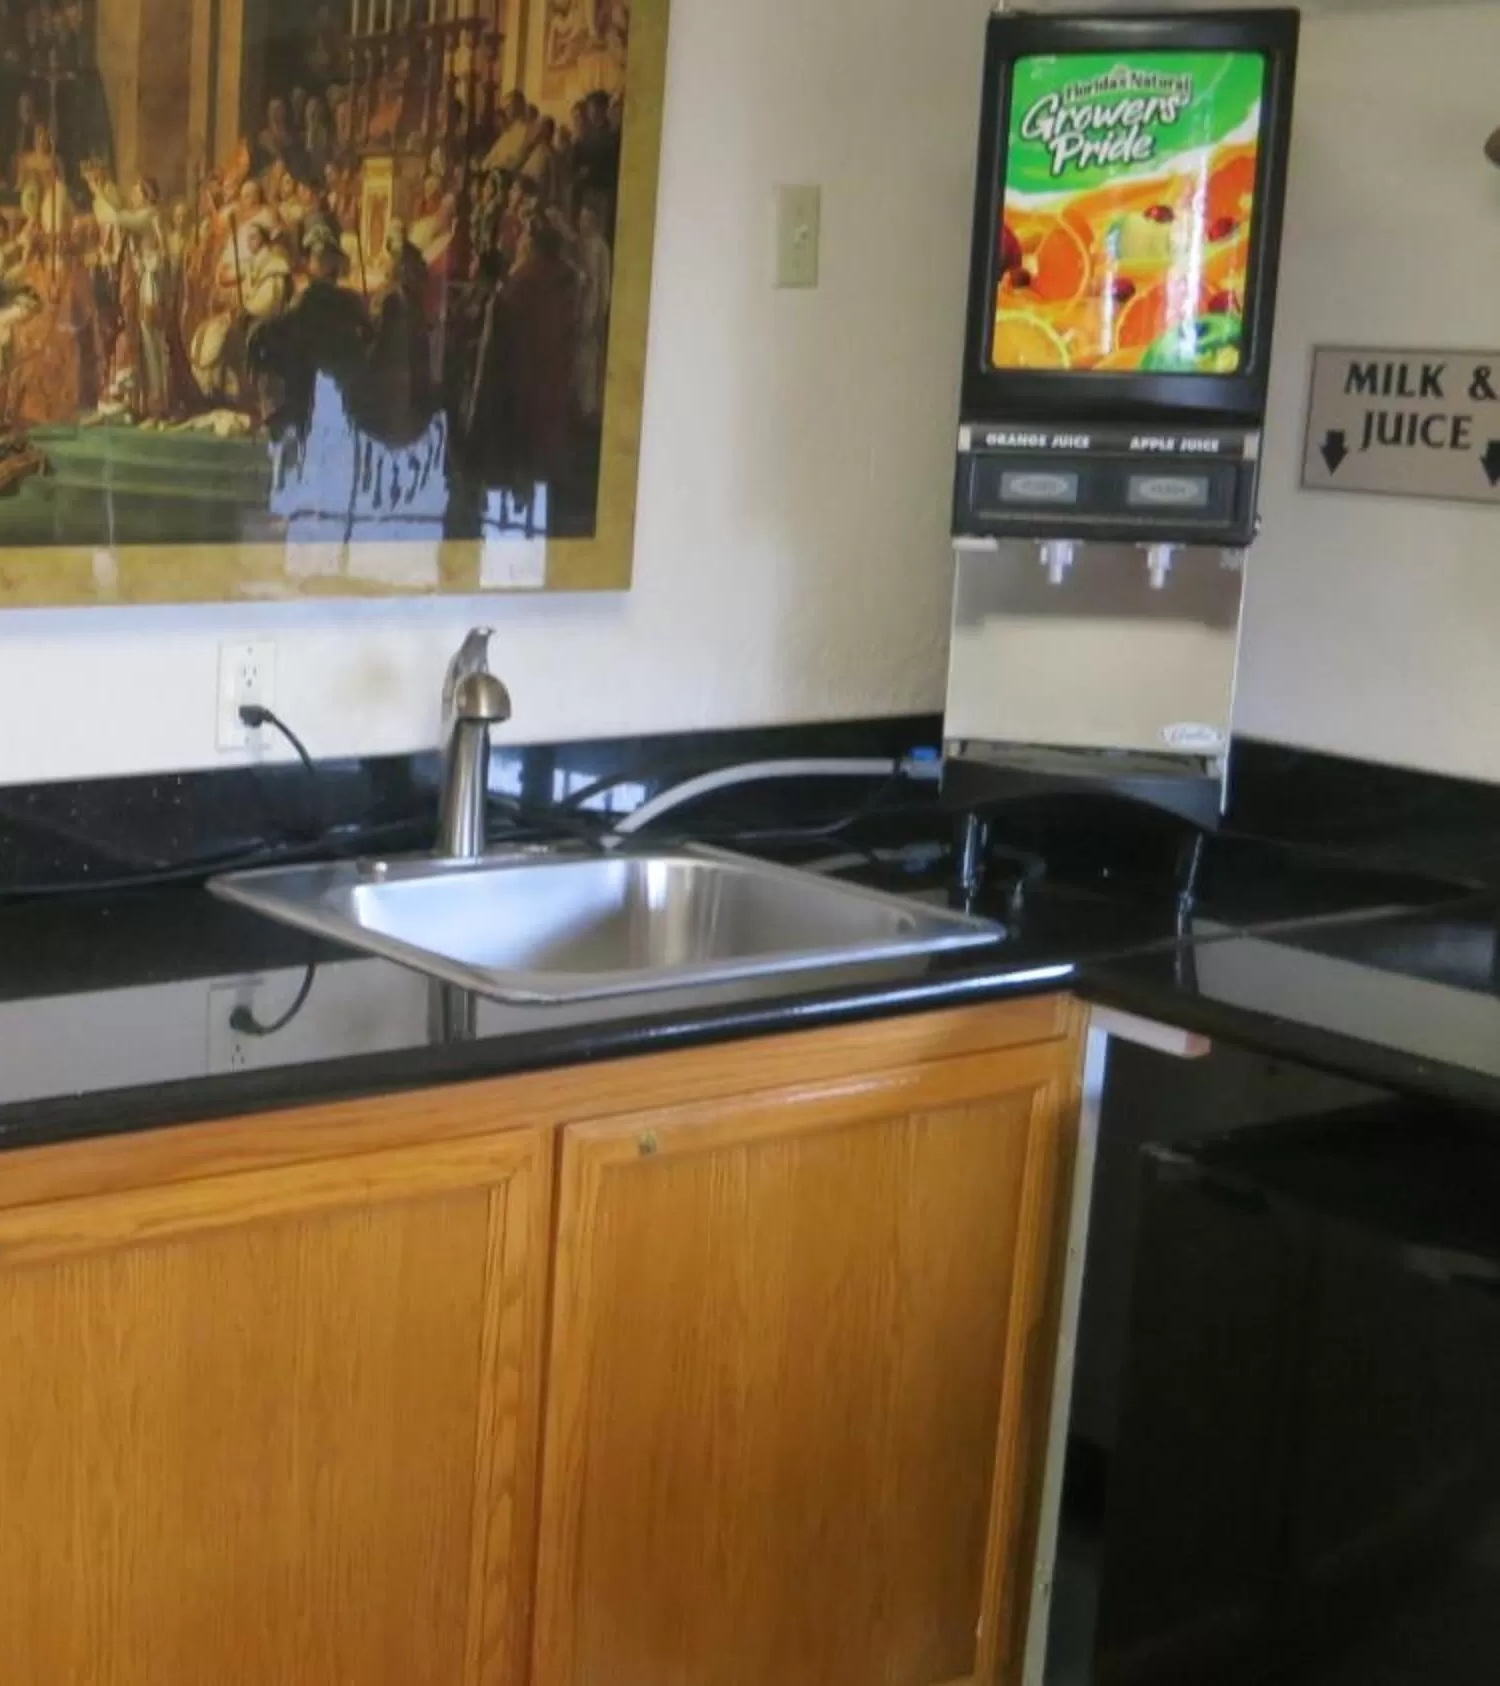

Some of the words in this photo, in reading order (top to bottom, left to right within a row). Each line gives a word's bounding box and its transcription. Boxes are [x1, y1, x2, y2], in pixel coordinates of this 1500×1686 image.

[1129, 70, 1191, 94] Natural
[1021, 93, 1190, 142] Growers
[1049, 123, 1154, 175] Pride
[1344, 361, 1447, 397] MILK
[1467, 364, 1498, 401] &
[986, 432, 1047, 448] ORANGE
[1051, 433, 1091, 449] JUICE
[1130, 435, 1175, 451] APPLE
[1179, 437, 1220, 453] JUICE
[1357, 410, 1473, 453] JUICE
